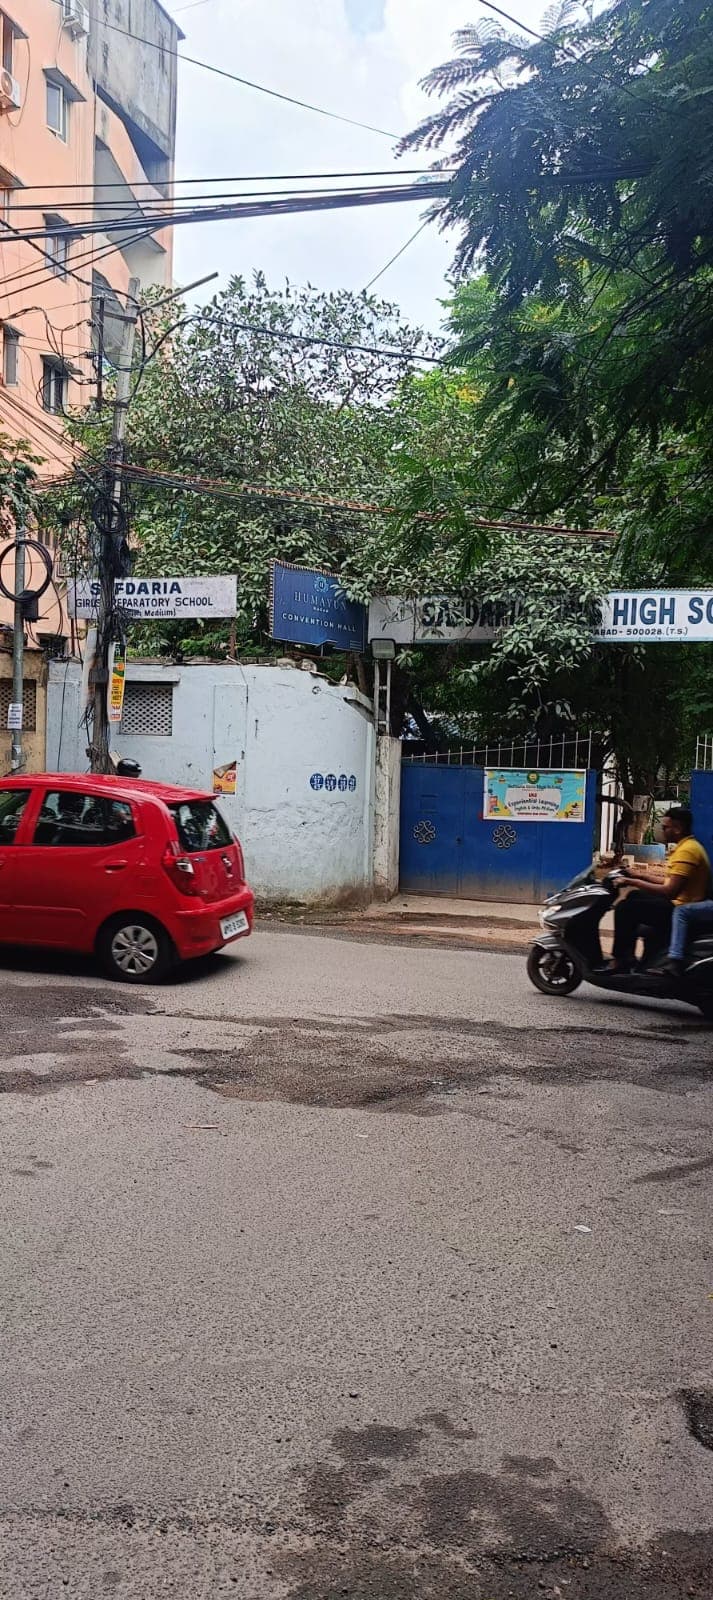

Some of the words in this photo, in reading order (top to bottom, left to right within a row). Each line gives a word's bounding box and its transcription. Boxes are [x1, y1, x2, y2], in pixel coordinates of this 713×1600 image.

[90, 582, 182, 596] SFDARIA
[110, 597, 170, 608] REPARATORY
[175, 597, 213, 606] SCHOOL
[144, 609, 176, 617] Medium)
[612, 597, 676, 626] HIGH
[282, 612, 334, 628] CONVENTION
[337, 623, 356, 632] HALL
